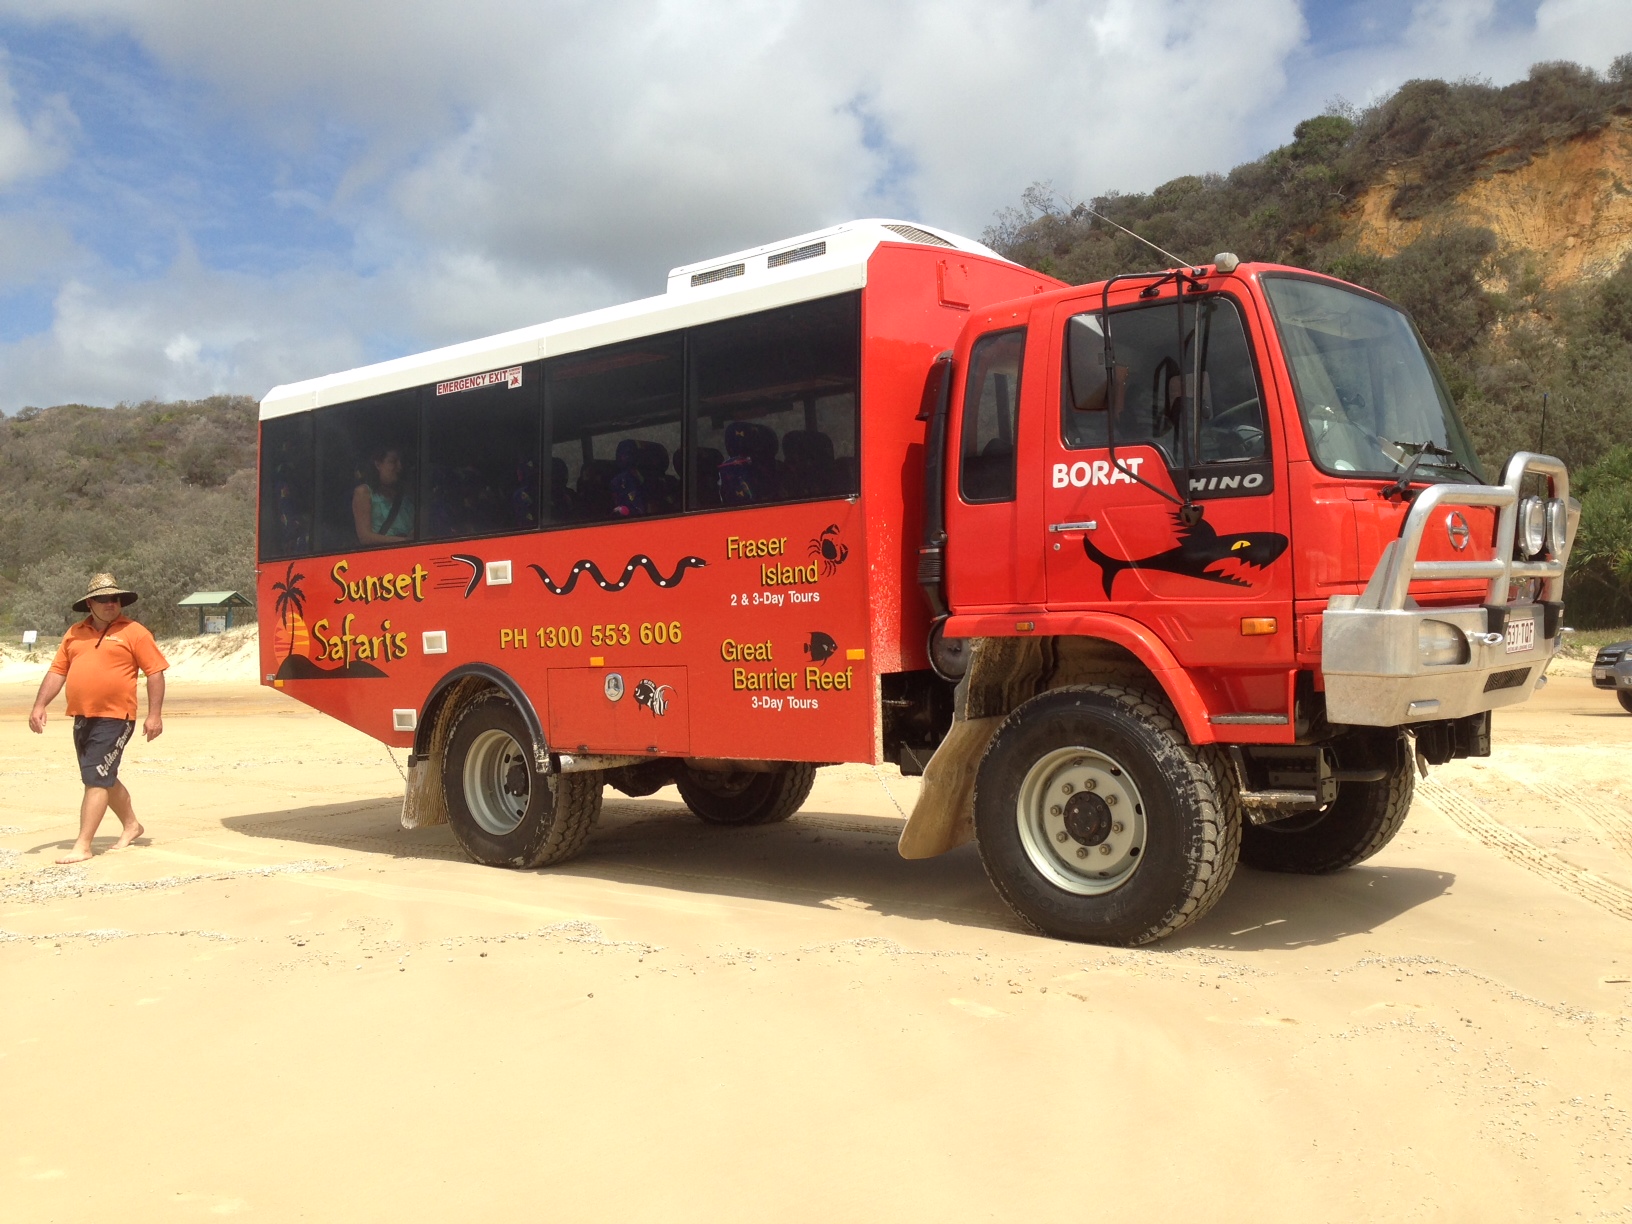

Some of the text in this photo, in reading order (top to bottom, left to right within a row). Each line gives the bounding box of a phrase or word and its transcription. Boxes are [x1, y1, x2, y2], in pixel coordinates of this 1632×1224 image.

[437, 375, 486, 394] EMERGENCY
[488, 370, 508, 384] EXIT
[1052, 458, 1144, 488] BORAT
[1189, 473, 1264, 491] HINO
[727, 536, 787, 559] Fraser
[331, 559, 429, 604] Sunset
[761, 560, 818, 586] Island
[730, 590, 820, 607] 2 & 3-Day Tours
[312, 613, 408, 669] Safaris
[500, 621, 682, 649] PH 1300 553 606
[721, 638, 773, 662] Great
[733, 666, 853, 691] Barrier Reef
[751, 696, 819, 712] 3-Day Tours
